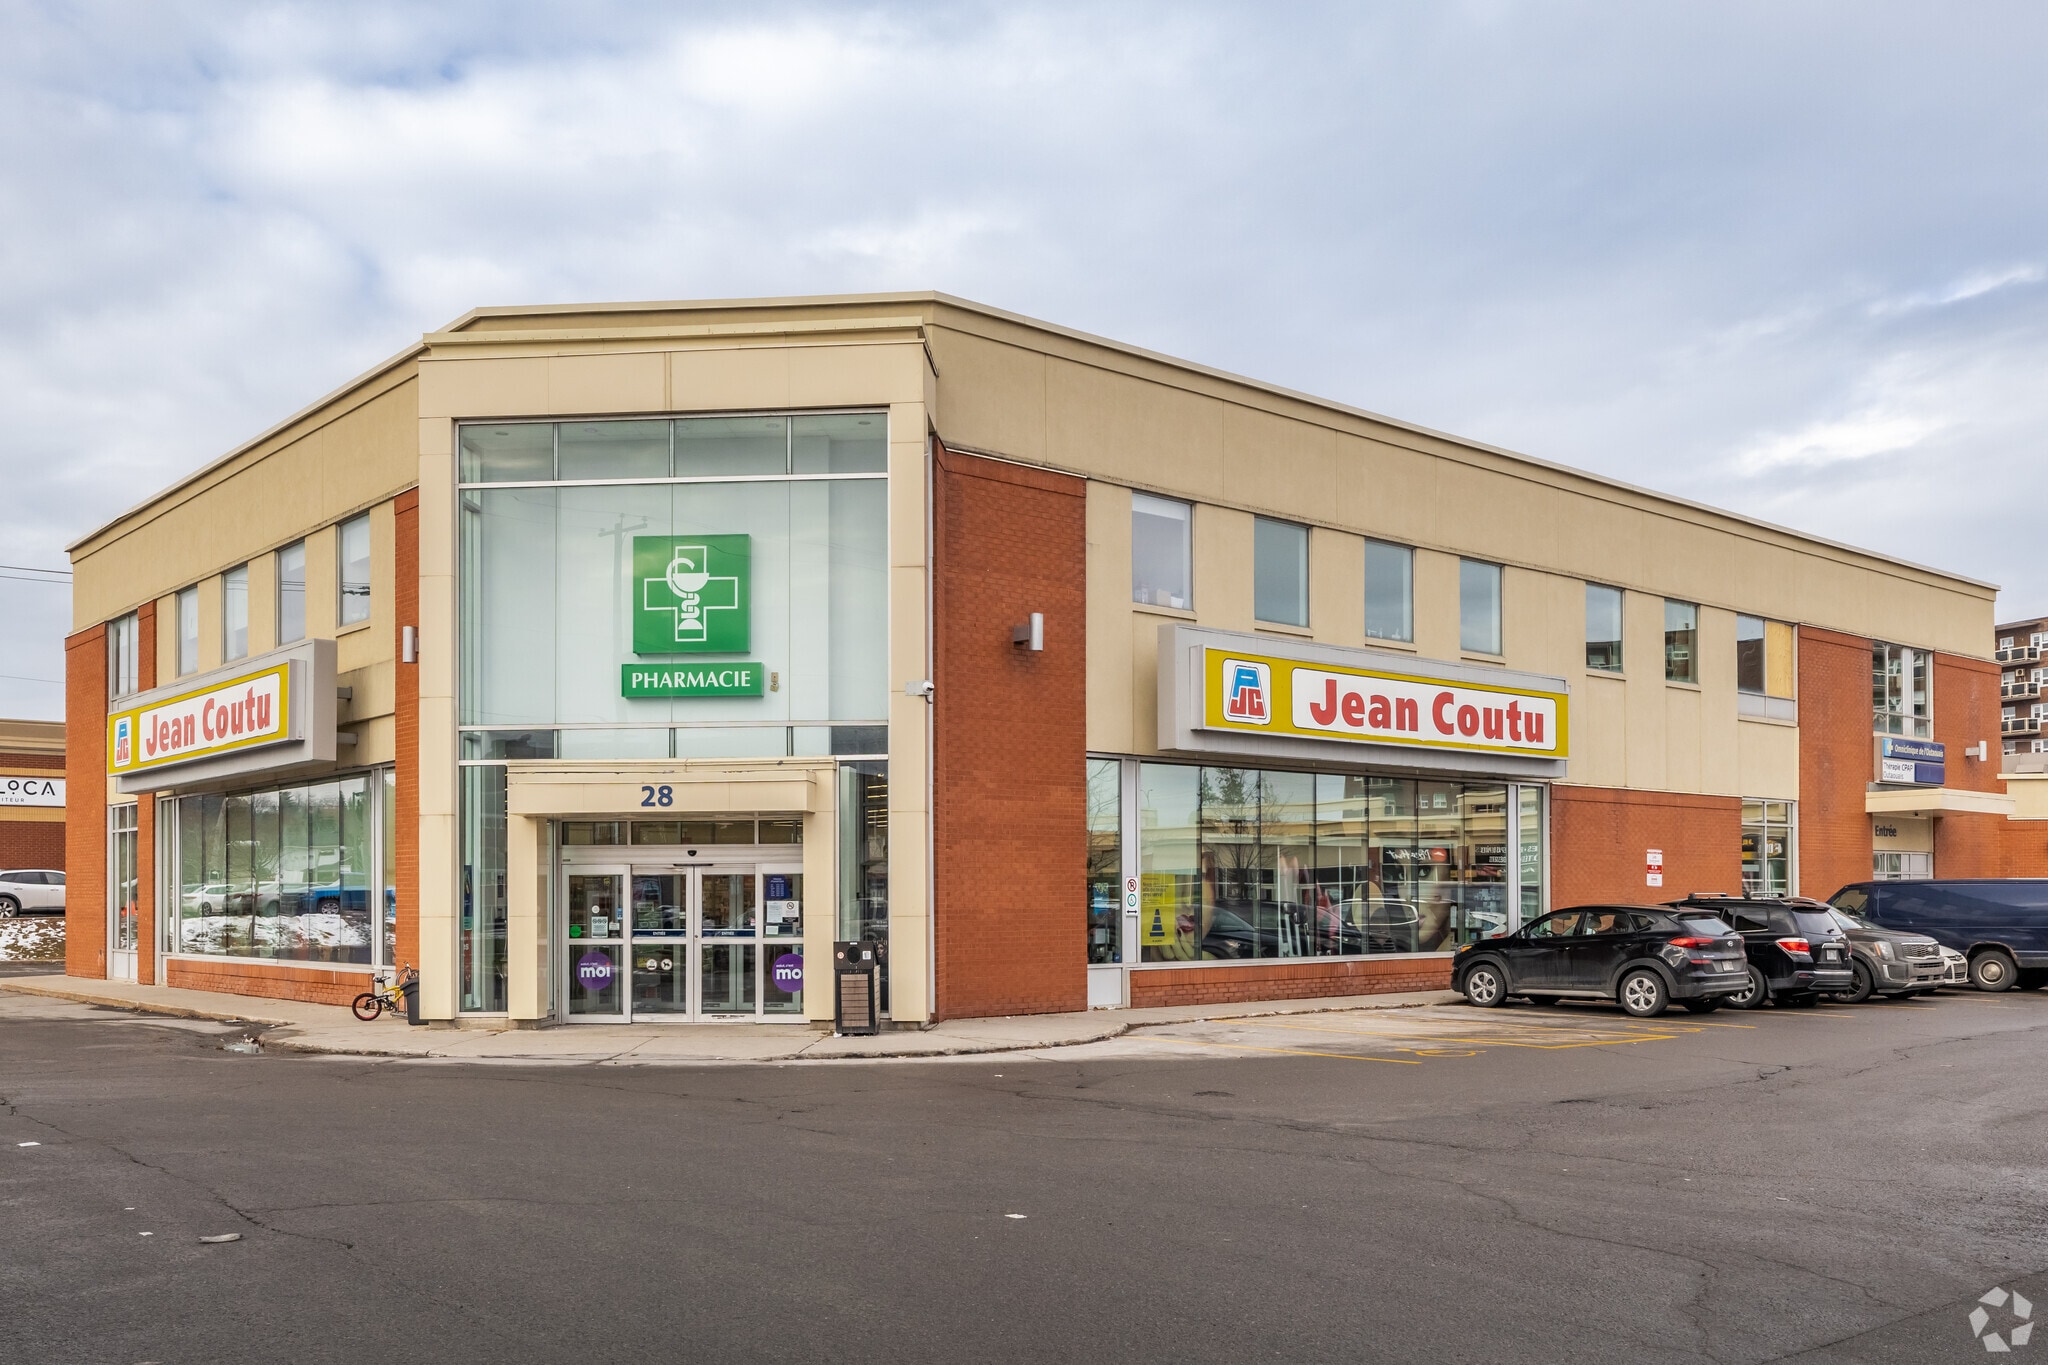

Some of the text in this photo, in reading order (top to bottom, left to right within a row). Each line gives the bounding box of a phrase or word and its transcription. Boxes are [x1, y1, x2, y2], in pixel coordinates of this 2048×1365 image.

[631, 670, 751, 689] PHARMACIE
[1310, 678, 1544, 743] Jean Coutu
[146, 686, 271, 757] Jean Coutu
[1919, 747, 1924, 756] de
[1901, 763, 1913, 772] CPAP
[640, 785, 674, 807] 28
[1875, 825, 1897, 837] Entrée
[580, 961, 611, 978] moi
[776, 968, 804, 980] mo
